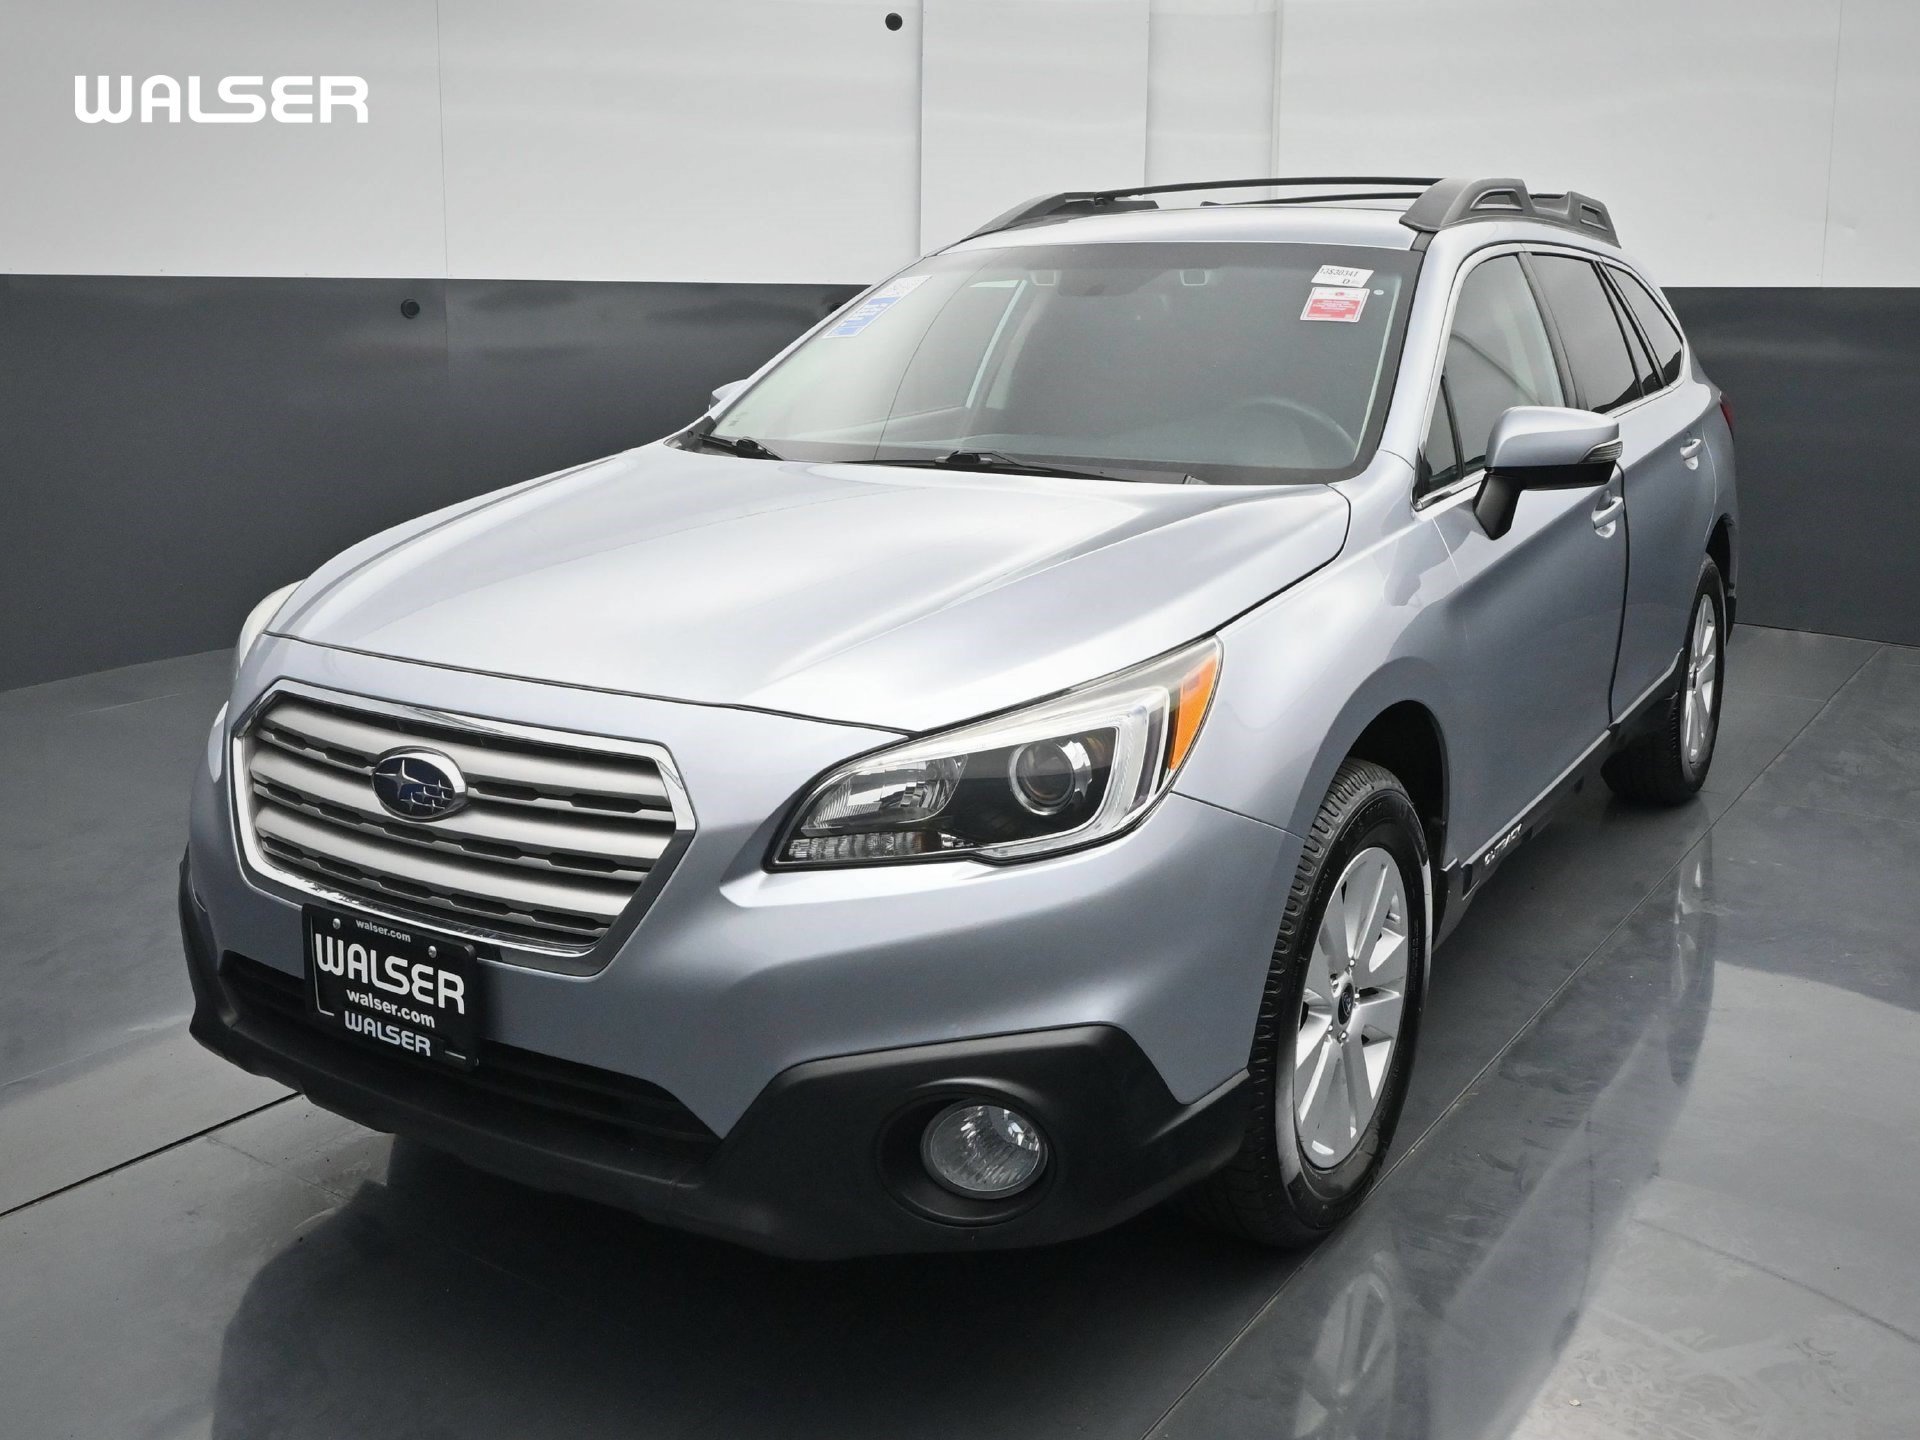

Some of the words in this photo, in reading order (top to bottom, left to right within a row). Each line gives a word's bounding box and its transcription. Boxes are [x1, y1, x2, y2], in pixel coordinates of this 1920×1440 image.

[355, 919, 411, 943] walser.com
[315, 933, 465, 1015] WALSER
[346, 989, 436, 1029] walser.com
[344, 1010, 431, 1057] WALSER
